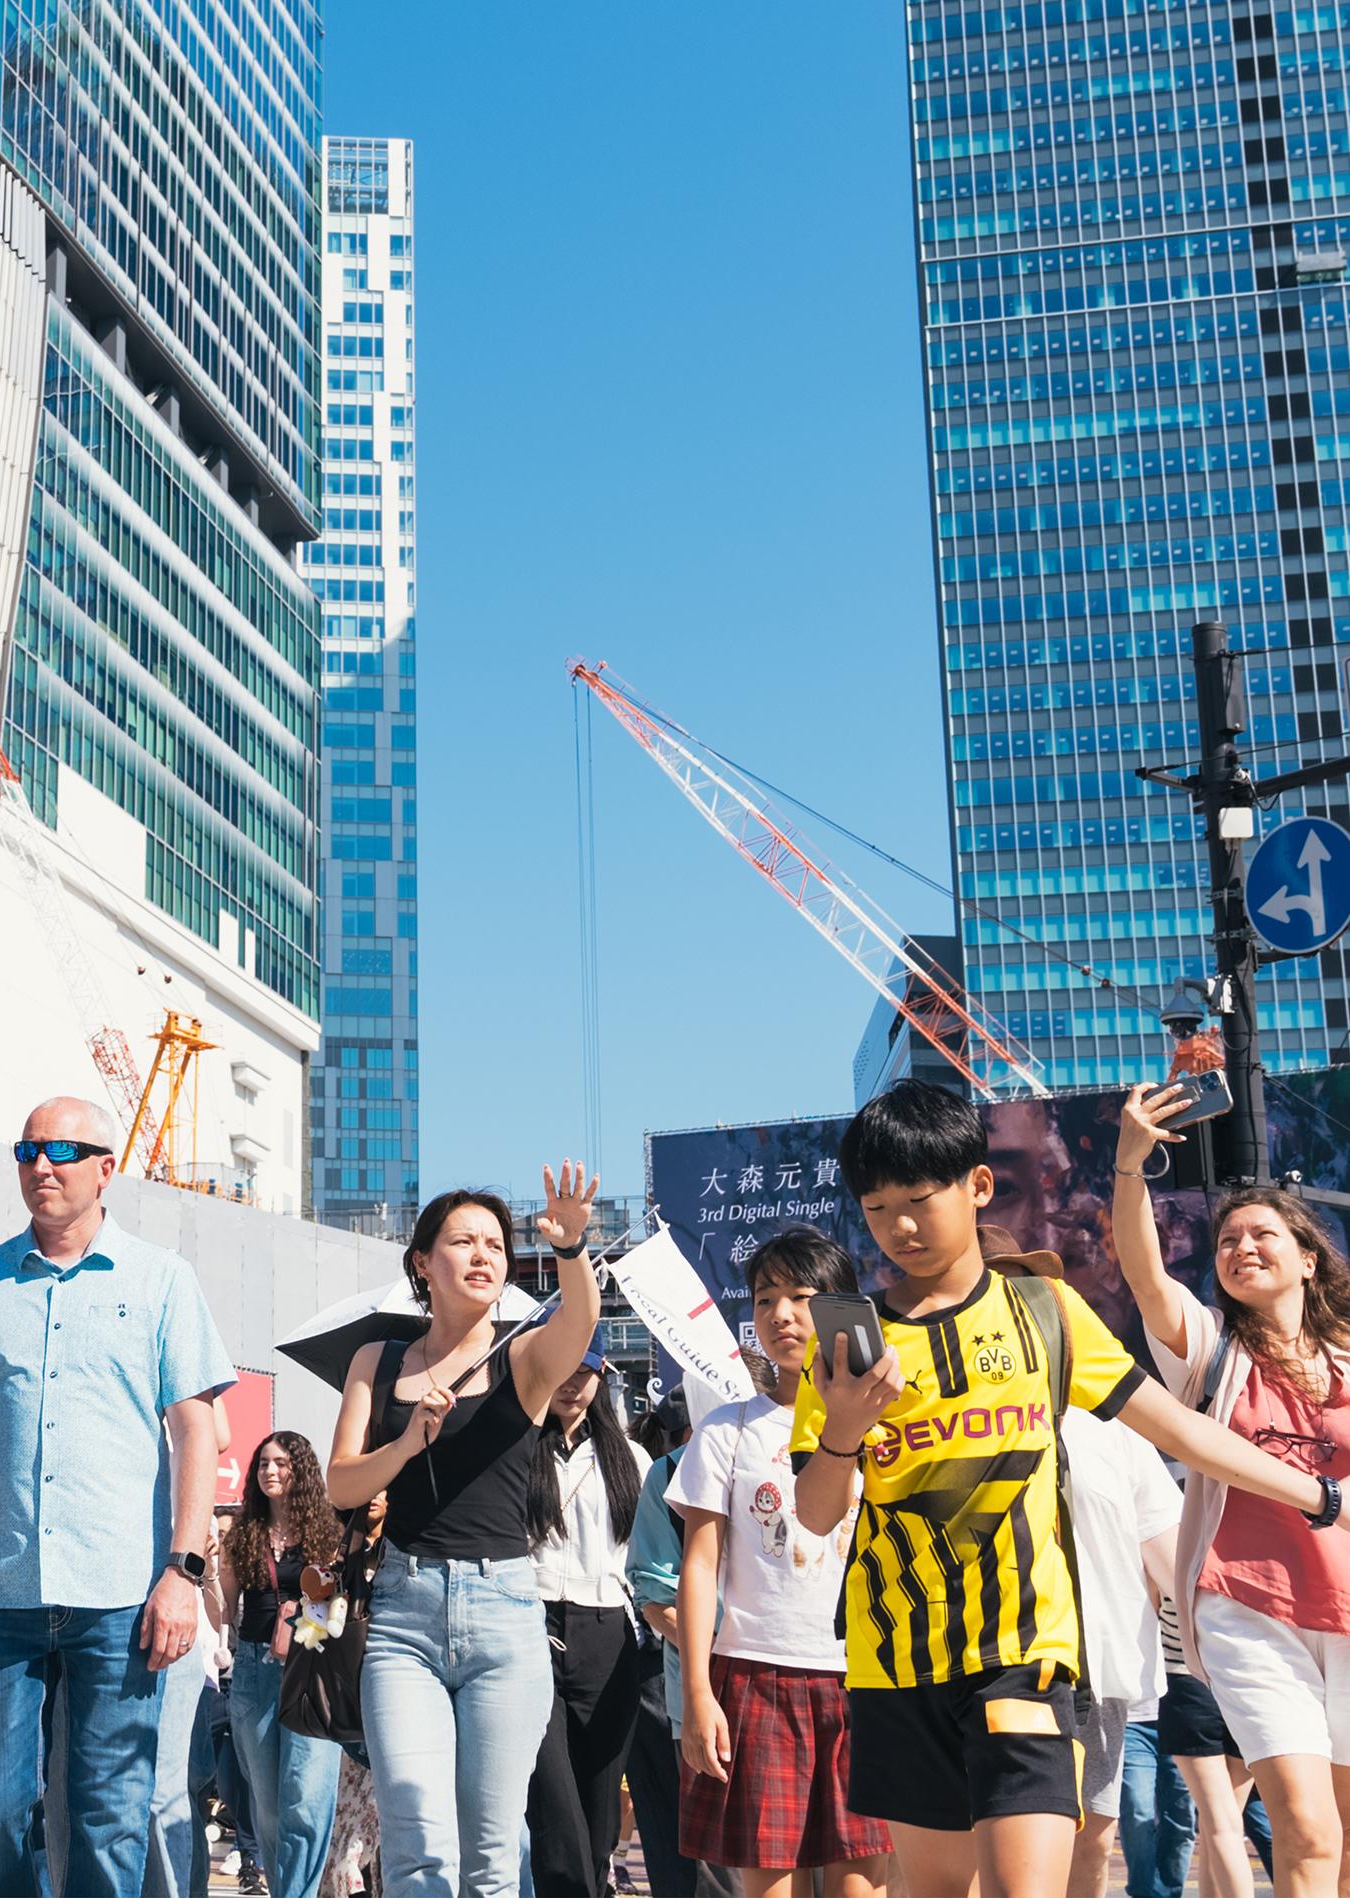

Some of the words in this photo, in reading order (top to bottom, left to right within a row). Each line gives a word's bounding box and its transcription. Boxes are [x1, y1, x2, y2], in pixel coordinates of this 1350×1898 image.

[699, 1158, 840, 1198] 大森元貴
[697, 1204, 725, 1223] 3rd
[728, 1200, 781, 1224] Digital
[785, 1197, 835, 1220] Single
[666, 1326, 720, 1381] Guide
[979, 1348, 1012, 1372] BVB
[991, 1371, 1004, 1381] 09
